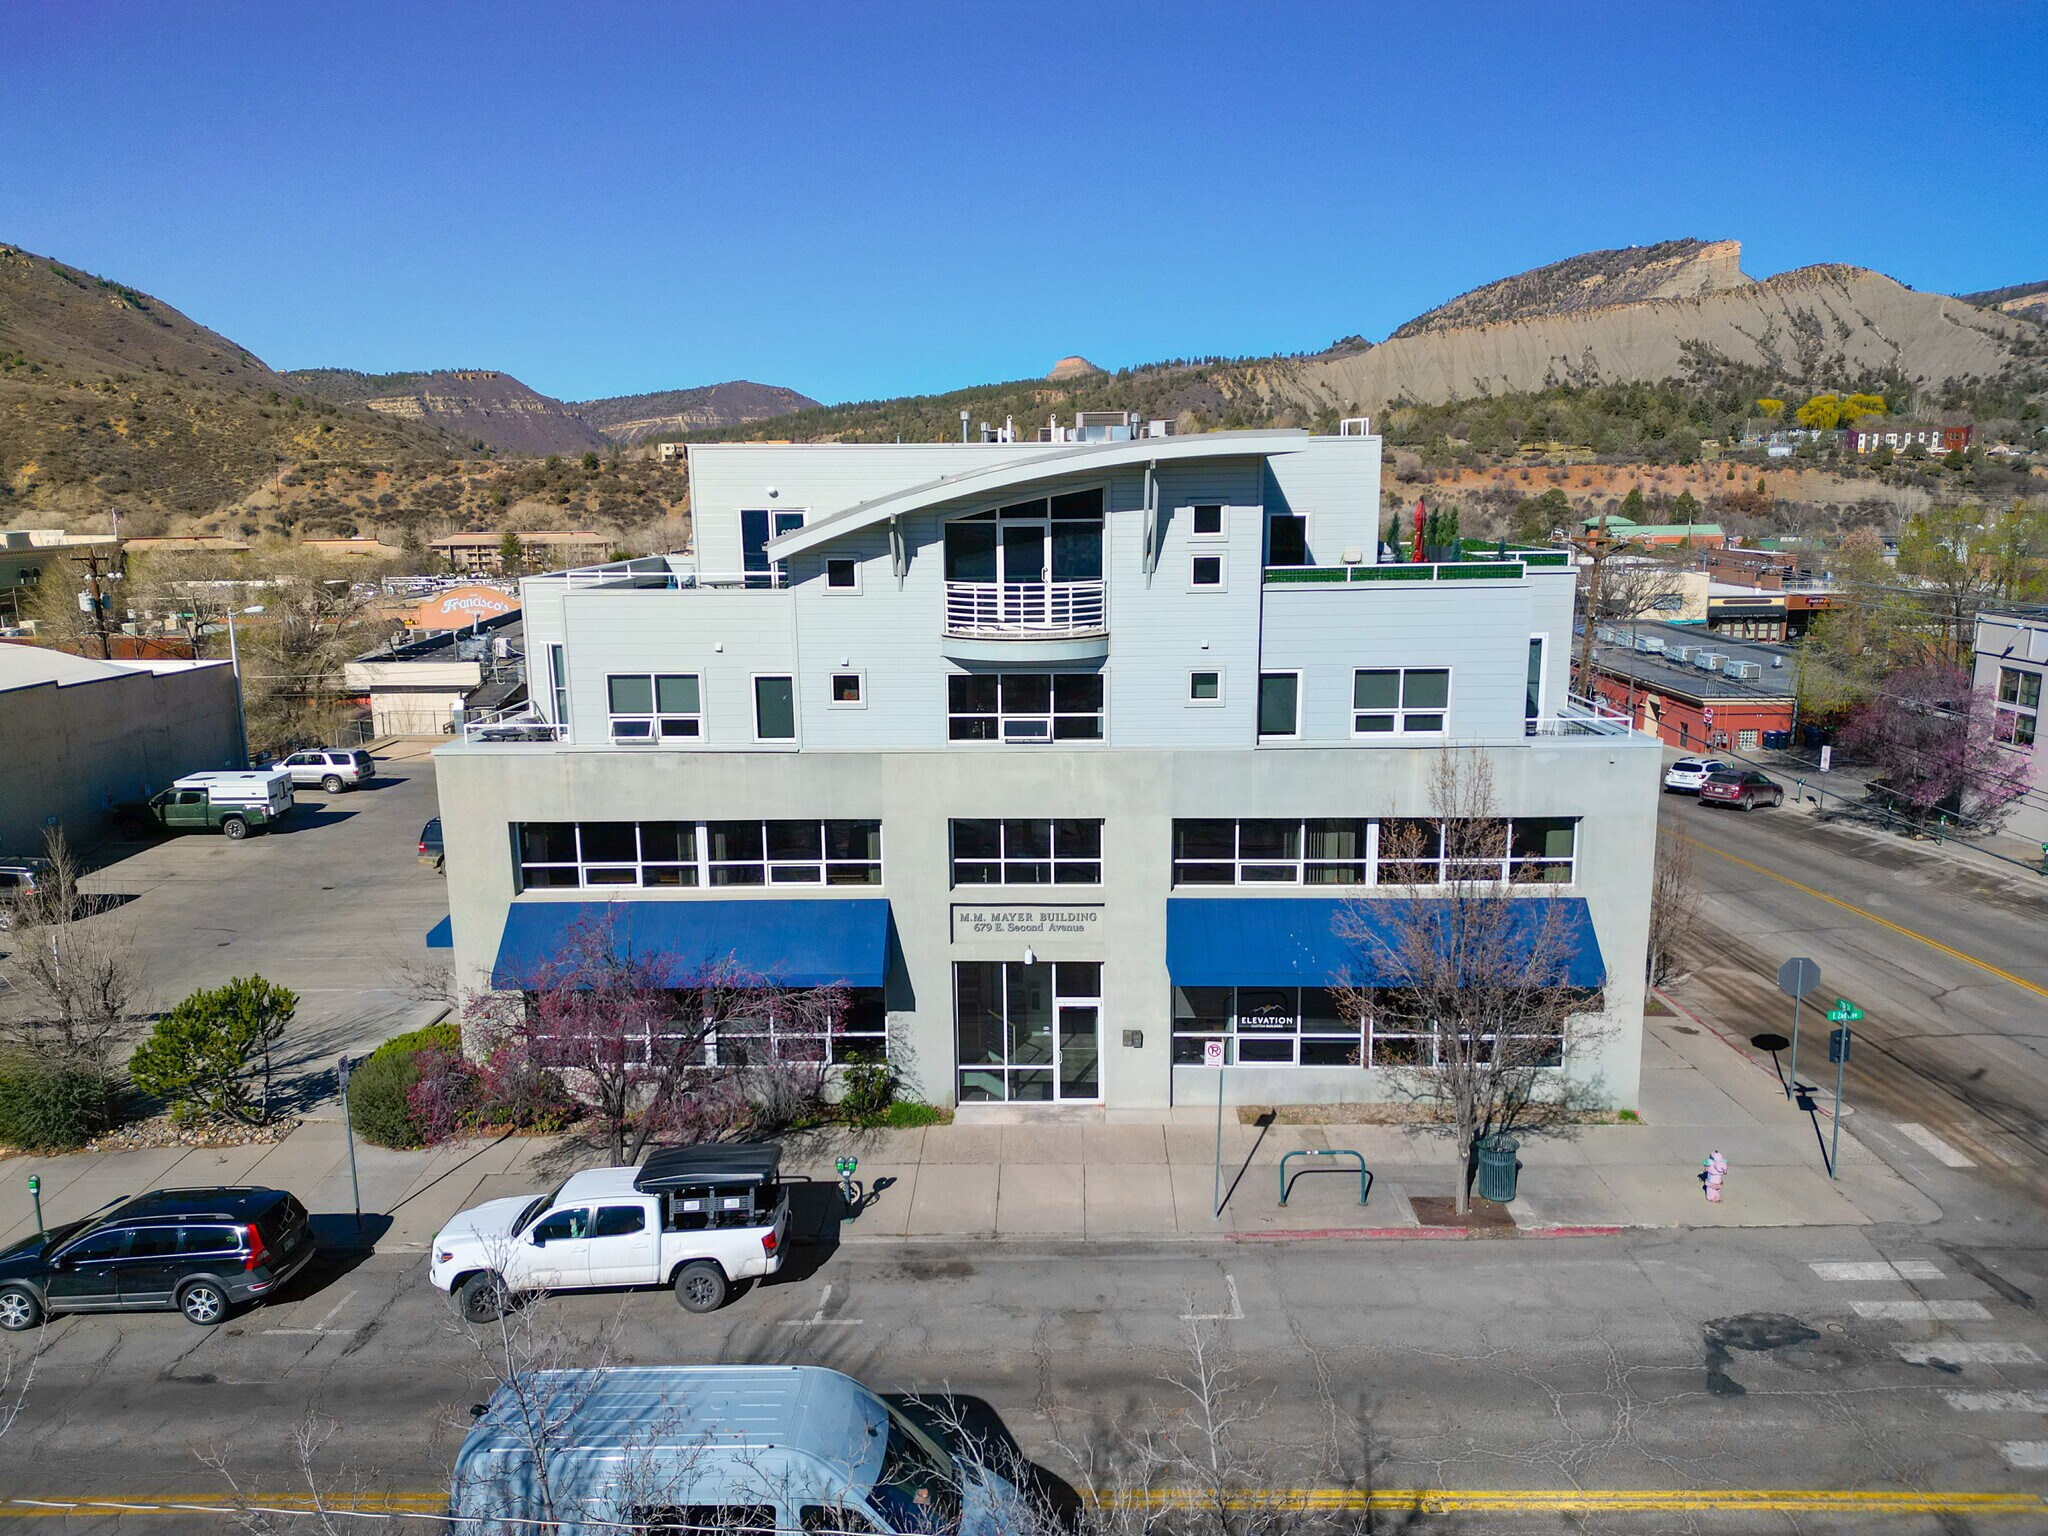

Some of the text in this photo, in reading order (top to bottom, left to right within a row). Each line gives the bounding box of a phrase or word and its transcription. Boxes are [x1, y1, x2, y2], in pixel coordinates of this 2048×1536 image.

[441, 596, 509, 613] Francisco's
[960, 912, 1098, 922] M.M. MAYER BUILDING
[974, 923, 1085, 932] 679 E. Second Avenue
[1241, 1016, 1293, 1024] ELEVATION
[1832, 1011, 1836, 1020] E
